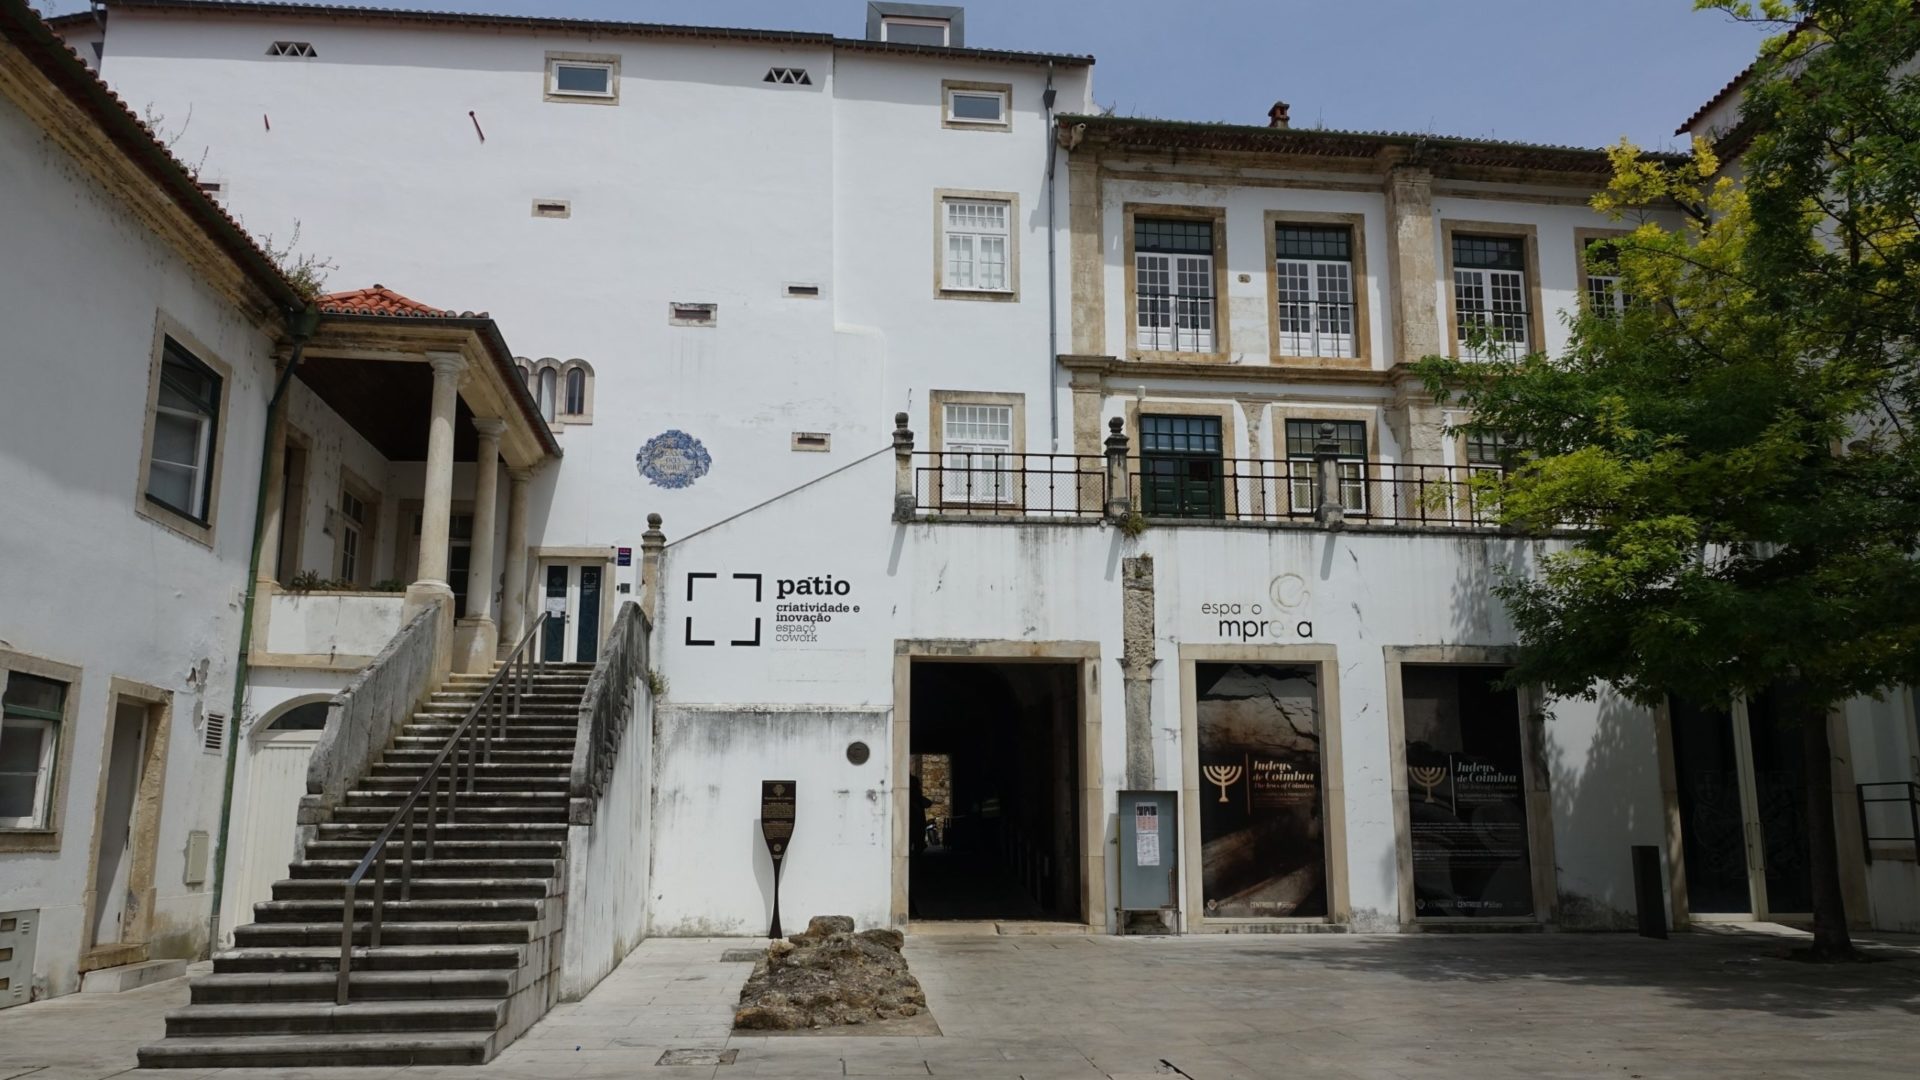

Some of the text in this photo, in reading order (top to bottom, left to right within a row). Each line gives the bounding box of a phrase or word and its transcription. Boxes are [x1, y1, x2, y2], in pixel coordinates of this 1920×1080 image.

[776, 602, 860, 613] criatividade e
[1201, 603, 1262, 617] espao
[776, 613, 832, 624] inovação
[775, 623, 816, 635] espaço
[775, 632, 818, 642] cowork
[1254, 760, 1292, 771] Judeus
[1457, 762, 1495, 773] Judeus
[1252, 771, 1314, 781] de Coimbra
[1457, 772, 1517, 783] de Coimbra
